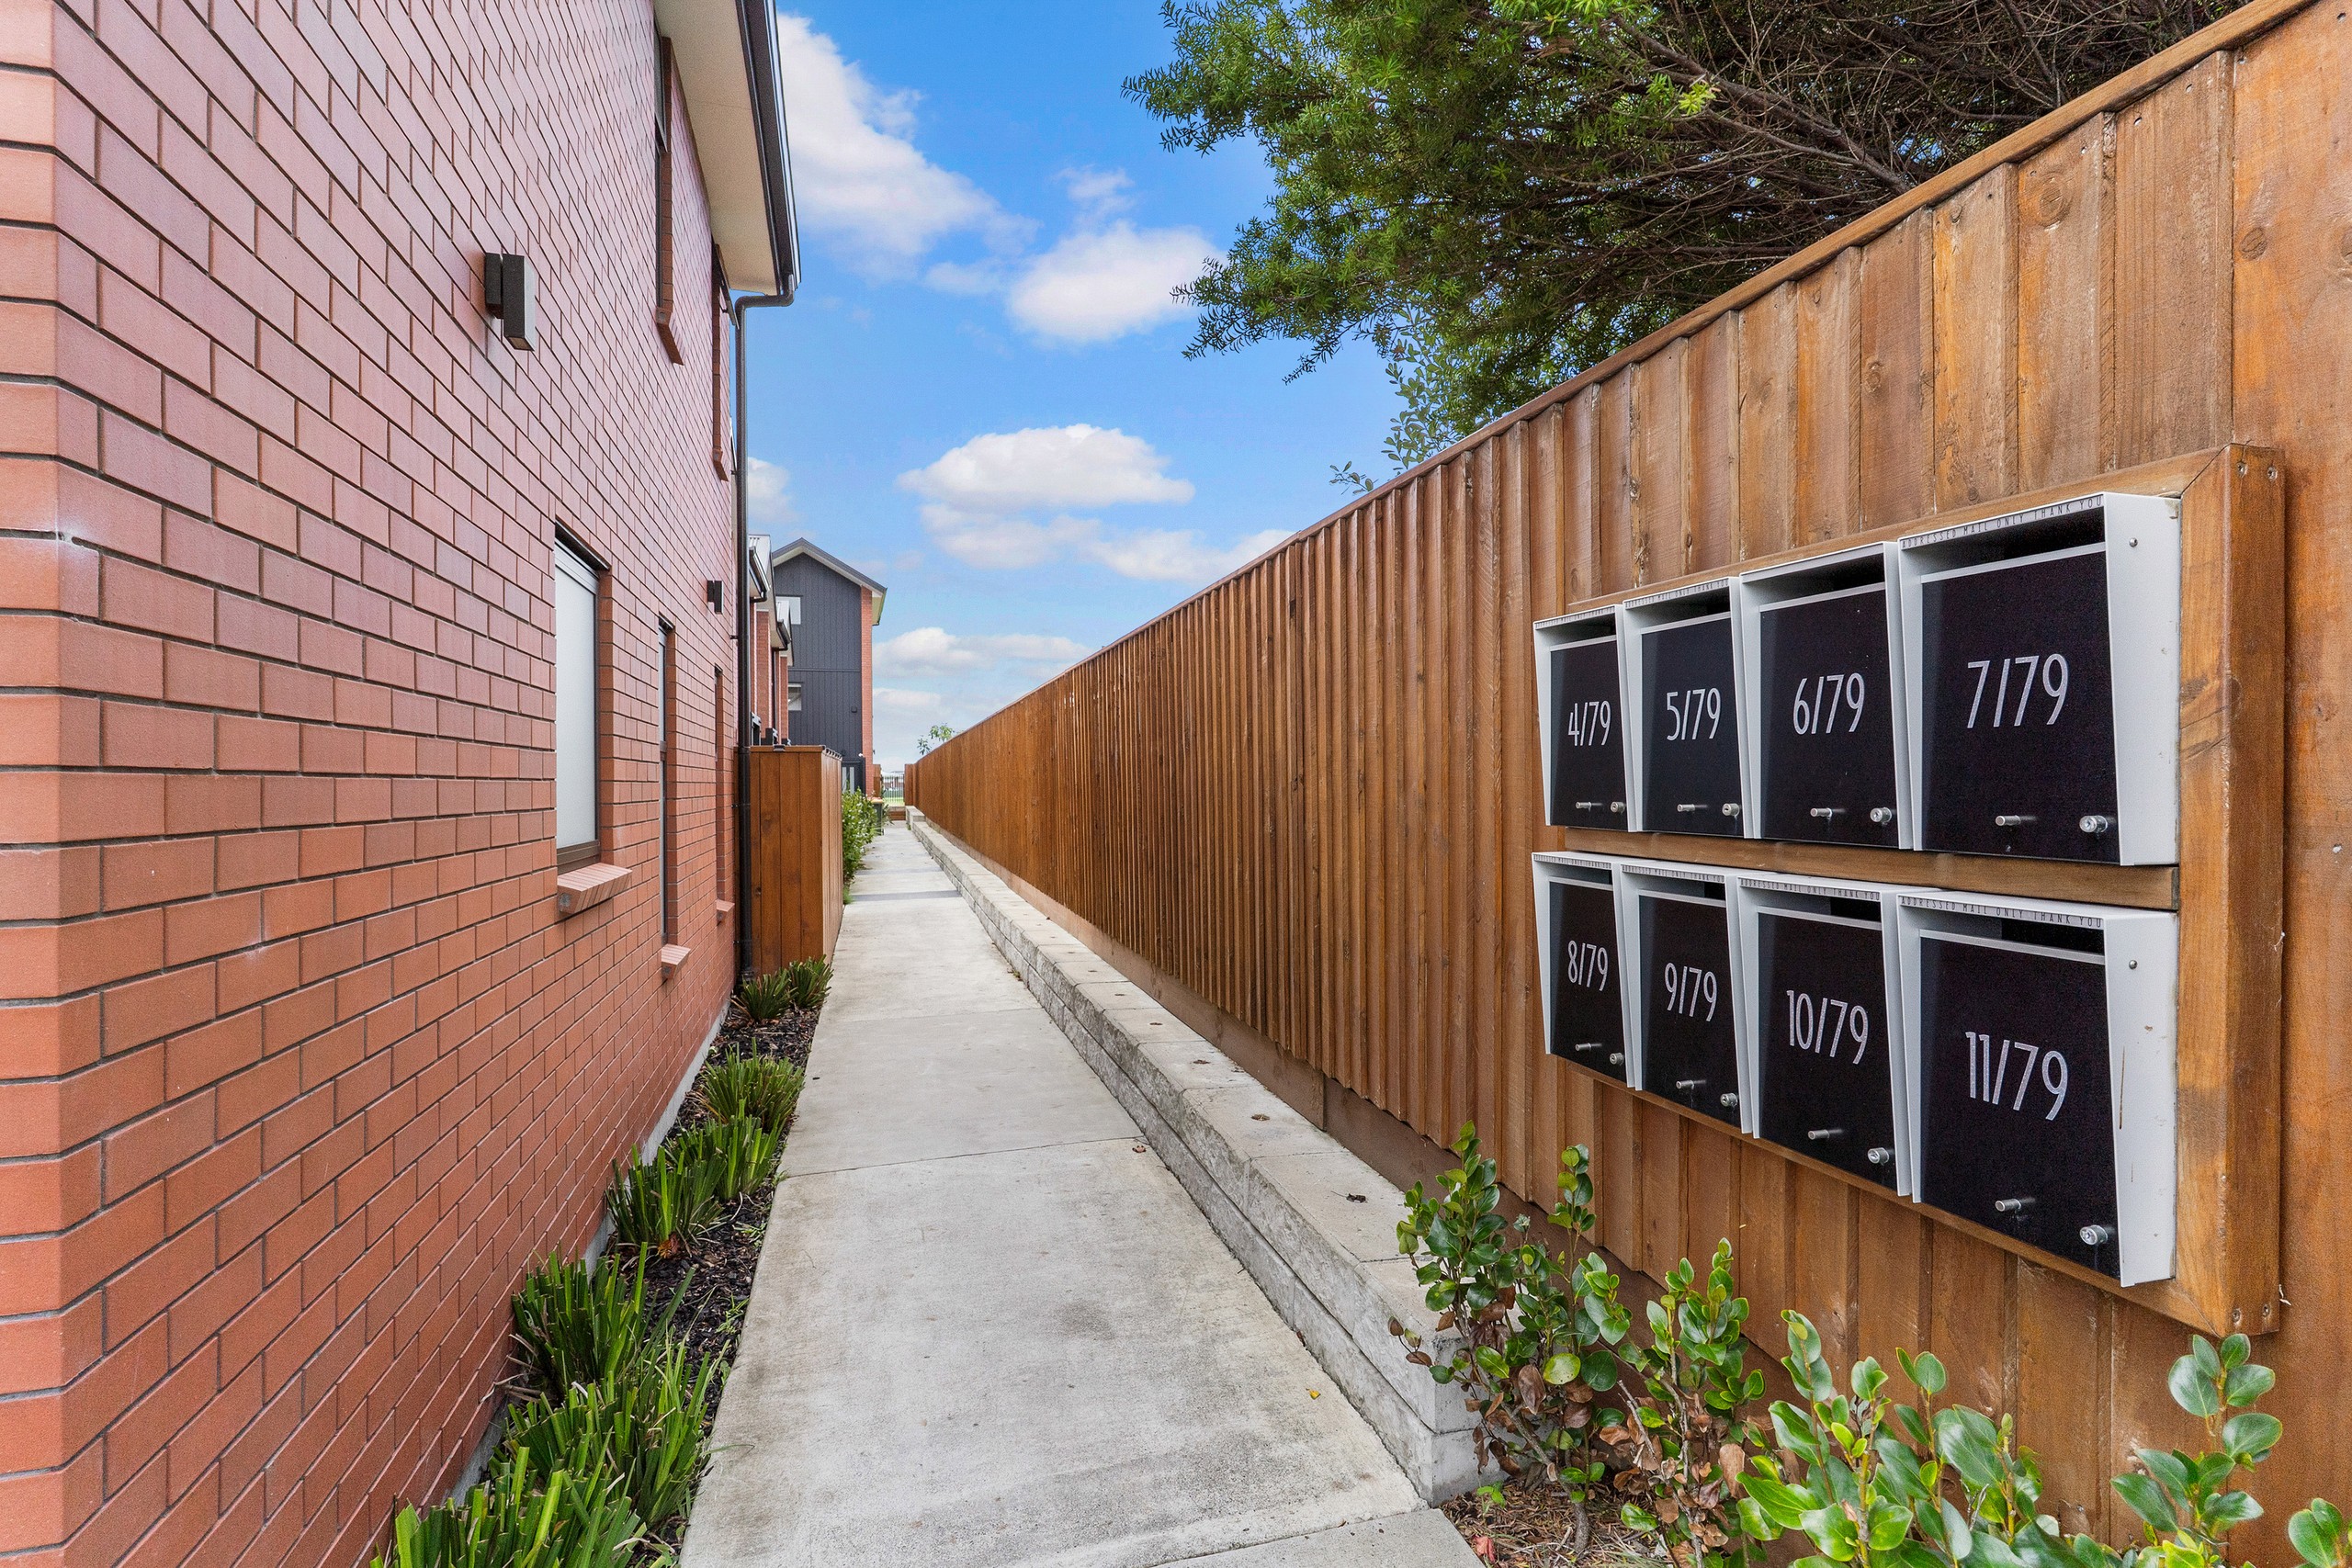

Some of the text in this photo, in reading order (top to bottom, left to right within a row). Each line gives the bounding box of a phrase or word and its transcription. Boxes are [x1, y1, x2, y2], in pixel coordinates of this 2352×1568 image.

[1902, 497, 2101, 548] ADDRESSED MAIL ONLY THANK YOU
[1666, 688, 1721, 740] 5/79
[1793, 672, 1865, 735] 6/79
[1967, 653, 2068, 728] 7/79
[1567, 701, 1611, 747] 4/79
[1833, 888, 1859, 897] THANK
[1864, 892, 1881, 901] YOU
[1901, 897, 2101, 928] ADDRESSED MAIL ONLY THANK YOU
[1567, 940, 1609, 992] 8/79
[1665, 963, 1718, 1021] 9/79
[1786, 989, 1869, 1065] 10/79
[1965, 1032, 2068, 1121] 11/79
